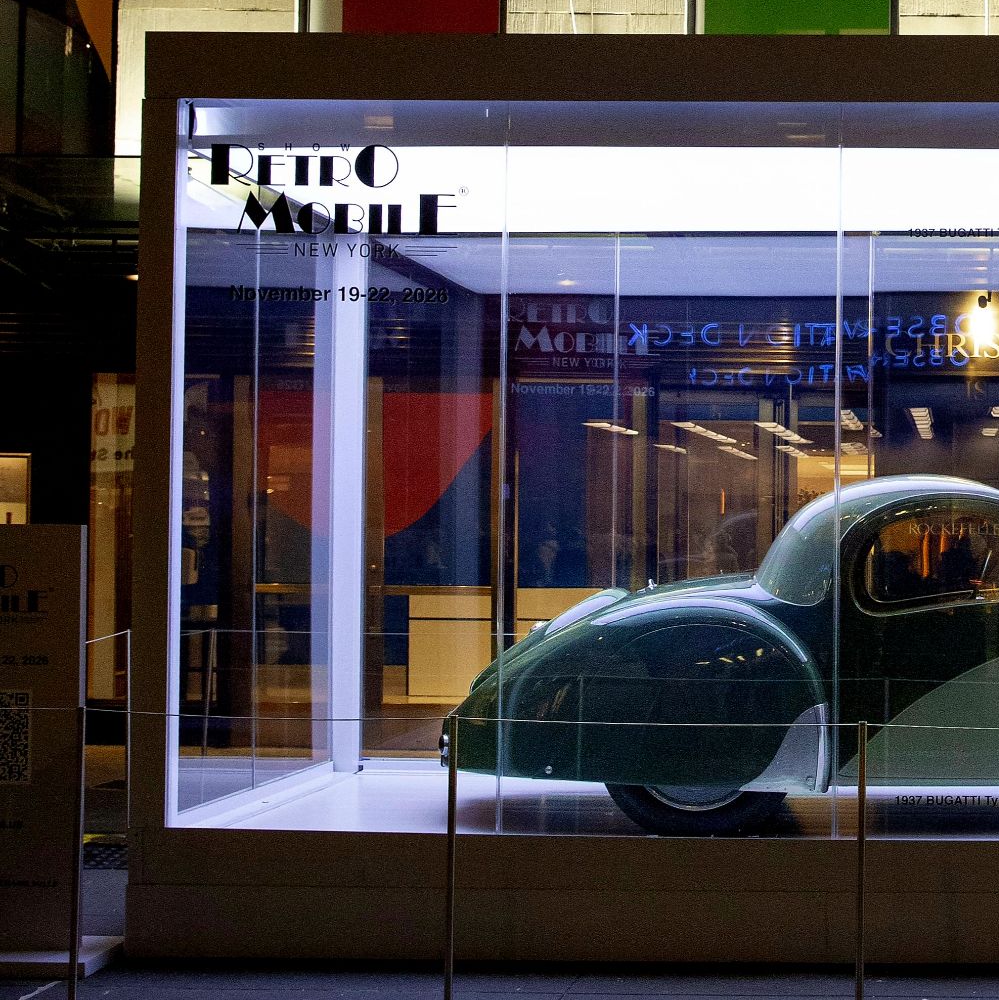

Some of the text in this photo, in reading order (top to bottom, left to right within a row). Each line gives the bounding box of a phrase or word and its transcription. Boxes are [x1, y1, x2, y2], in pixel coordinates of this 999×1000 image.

[211, 143, 399, 188] RETRO
[907, 228, 935, 238] 1937
[939, 228, 994, 238] BUGATTI
[294, 242, 401, 259] NEW YORK
[230, 284, 449, 306] November 19-22, 2026
[894, 795, 923, 806] 1937
[926, 795, 981, 806] BUGATTI
